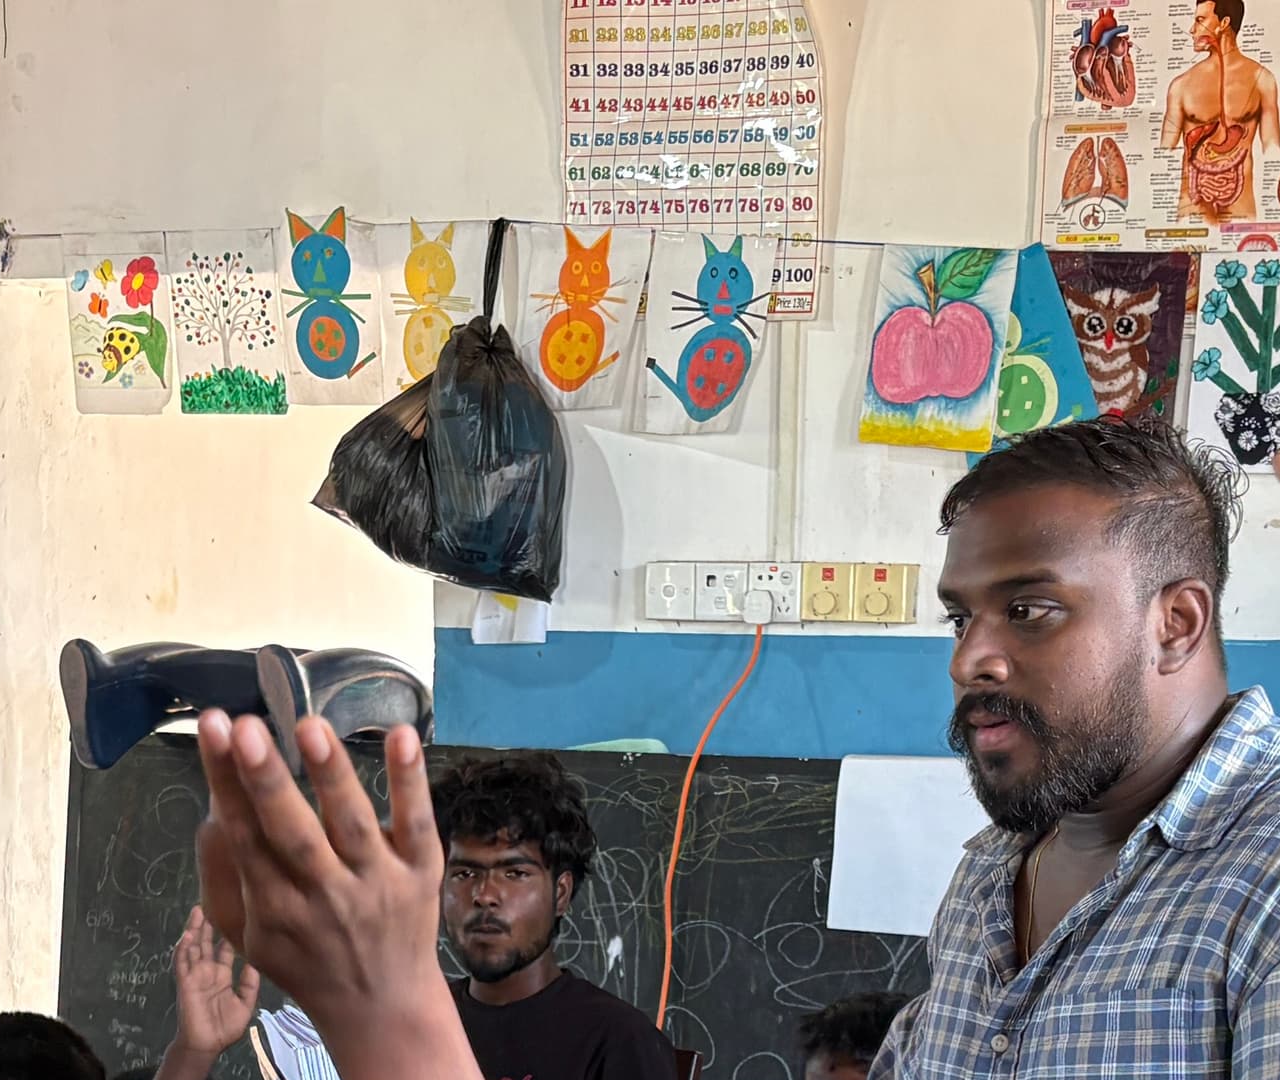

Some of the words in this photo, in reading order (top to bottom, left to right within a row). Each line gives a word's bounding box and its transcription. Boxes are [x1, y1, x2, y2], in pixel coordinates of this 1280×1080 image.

[569, 63, 590, 77] 31
[597, 63, 618, 77] 32
[623, 63, 644, 77] 33
[649, 62, 670, 77] 34
[675, 61, 695, 76] 35
[699, 60, 718, 75] 36
[723, 58, 742, 73] 37
[747, 57, 766, 71] 38
[770, 55, 789, 70] 39
[796, 52, 814, 68] 40
[569, 98, 591, 112] 41
[596, 98, 618, 112] 42
[623, 97, 643, 112] 43
[647, 97, 668, 112] 44
[672, 96, 693, 111] 45
[697, 95, 717, 110] 46
[721, 94, 740, 109] 47
[746, 92, 765, 107] 48
[769, 91, 789, 106] 49
[796, 89, 815, 105] 50
[570, 133, 589, 147] 51
[594, 132, 615, 147] 52
[619, 132, 638, 146] 53
[642, 131, 663, 145] 54
[668, 130, 688, 144] 55
[693, 129, 714, 144] 56
[718, 129, 739, 143] 57
[743, 128, 764, 143] 58
[568, 167, 586, 181] 61
[591, 166, 611, 180] 62
[715, 163, 735, 178] 67
[740, 162, 761, 177] 68
[765, 162, 786, 176] 69
[569, 201, 587, 216] 71
[592, 200, 611, 215] 72
[616, 200, 636, 215] 73
[639, 200, 660, 214] 74
[664, 199, 685, 213] 75
[688, 199, 709, 213] 76
[713, 199, 733, 213] 77
[738, 198, 759, 212] 78
[764, 197, 784, 212] 79
[792, 196, 813, 211] 80
[785, 268, 813, 282] 100
